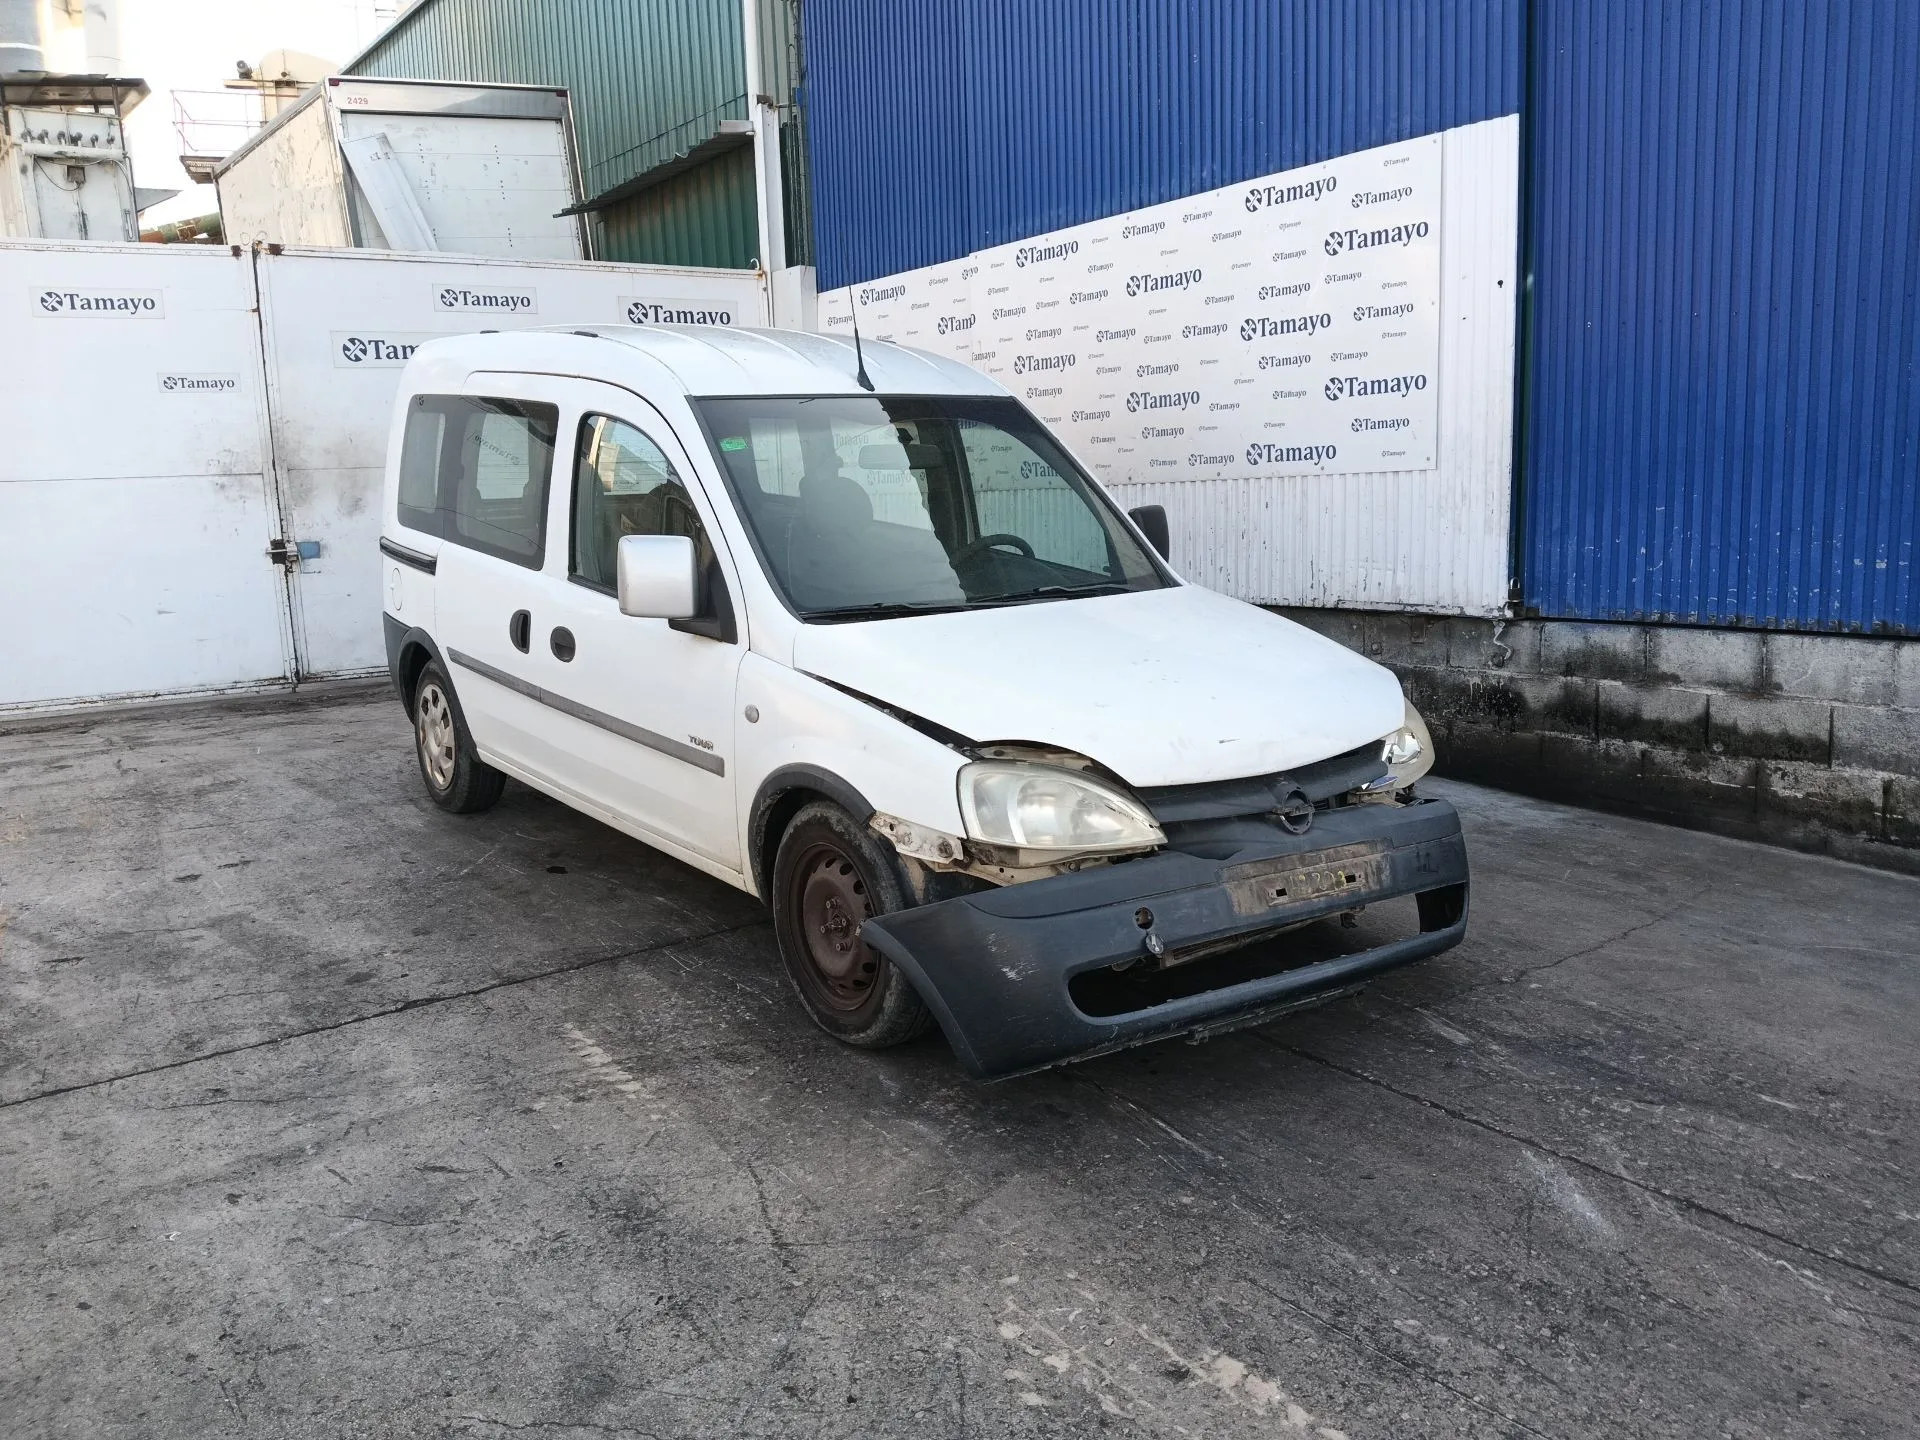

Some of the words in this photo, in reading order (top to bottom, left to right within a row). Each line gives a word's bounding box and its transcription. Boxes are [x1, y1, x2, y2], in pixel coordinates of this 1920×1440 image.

[347, 97, 369, 105] 2429
[1263, 176, 1337, 207] Tamayo
[1363, 186, 1413, 205] Tamayo
[1131, 221, 1165, 237] Tamayo
[1344, 221, 1429, 251] Tamayo
[1028, 240, 1079, 264] Tamayo
[1141, 268, 1202, 293] Tamayo
[1331, 271, 1362, 283] Tamayo
[869, 285, 906, 303] Tamayo
[1077, 288, 1109, 303] Tamayo
[1269, 282, 1311, 298] Tamayo
[64, 293, 156, 315] Tamayo
[459, 290, 530, 311] Tamayo
[999, 306, 1026, 318] Tamayo
[1365, 303, 1414, 319] Tamayo
[1191, 323, 1228, 337] Tamayo
[1258, 313, 1332, 337] Tamayo
[1033, 327, 1062, 340] Tamayo
[1104, 327, 1136, 340] Tamayo
[368, 340, 419, 360] Tam
[1337, 351, 1368, 360] Tamayo
[1026, 353, 1076, 372] Tamayo
[1269, 354, 1311, 368] Tamayo
[1144, 363, 1179, 376] Tamayo
[177, 377, 235, 391] Tamayo
[1345, 374, 1427, 398] Tamayo
[1034, 386, 1063, 399] Tamayo
[1141, 390, 1200, 411] Tamayo
[1079, 410, 1111, 423] Tamayo
[1362, 417, 1410, 431] Tamayo
[1150, 426, 1185, 439] Tamayo
[1197, 454, 1235, 467] Tamayo
[1263, 443, 1337, 466] Tamayo
